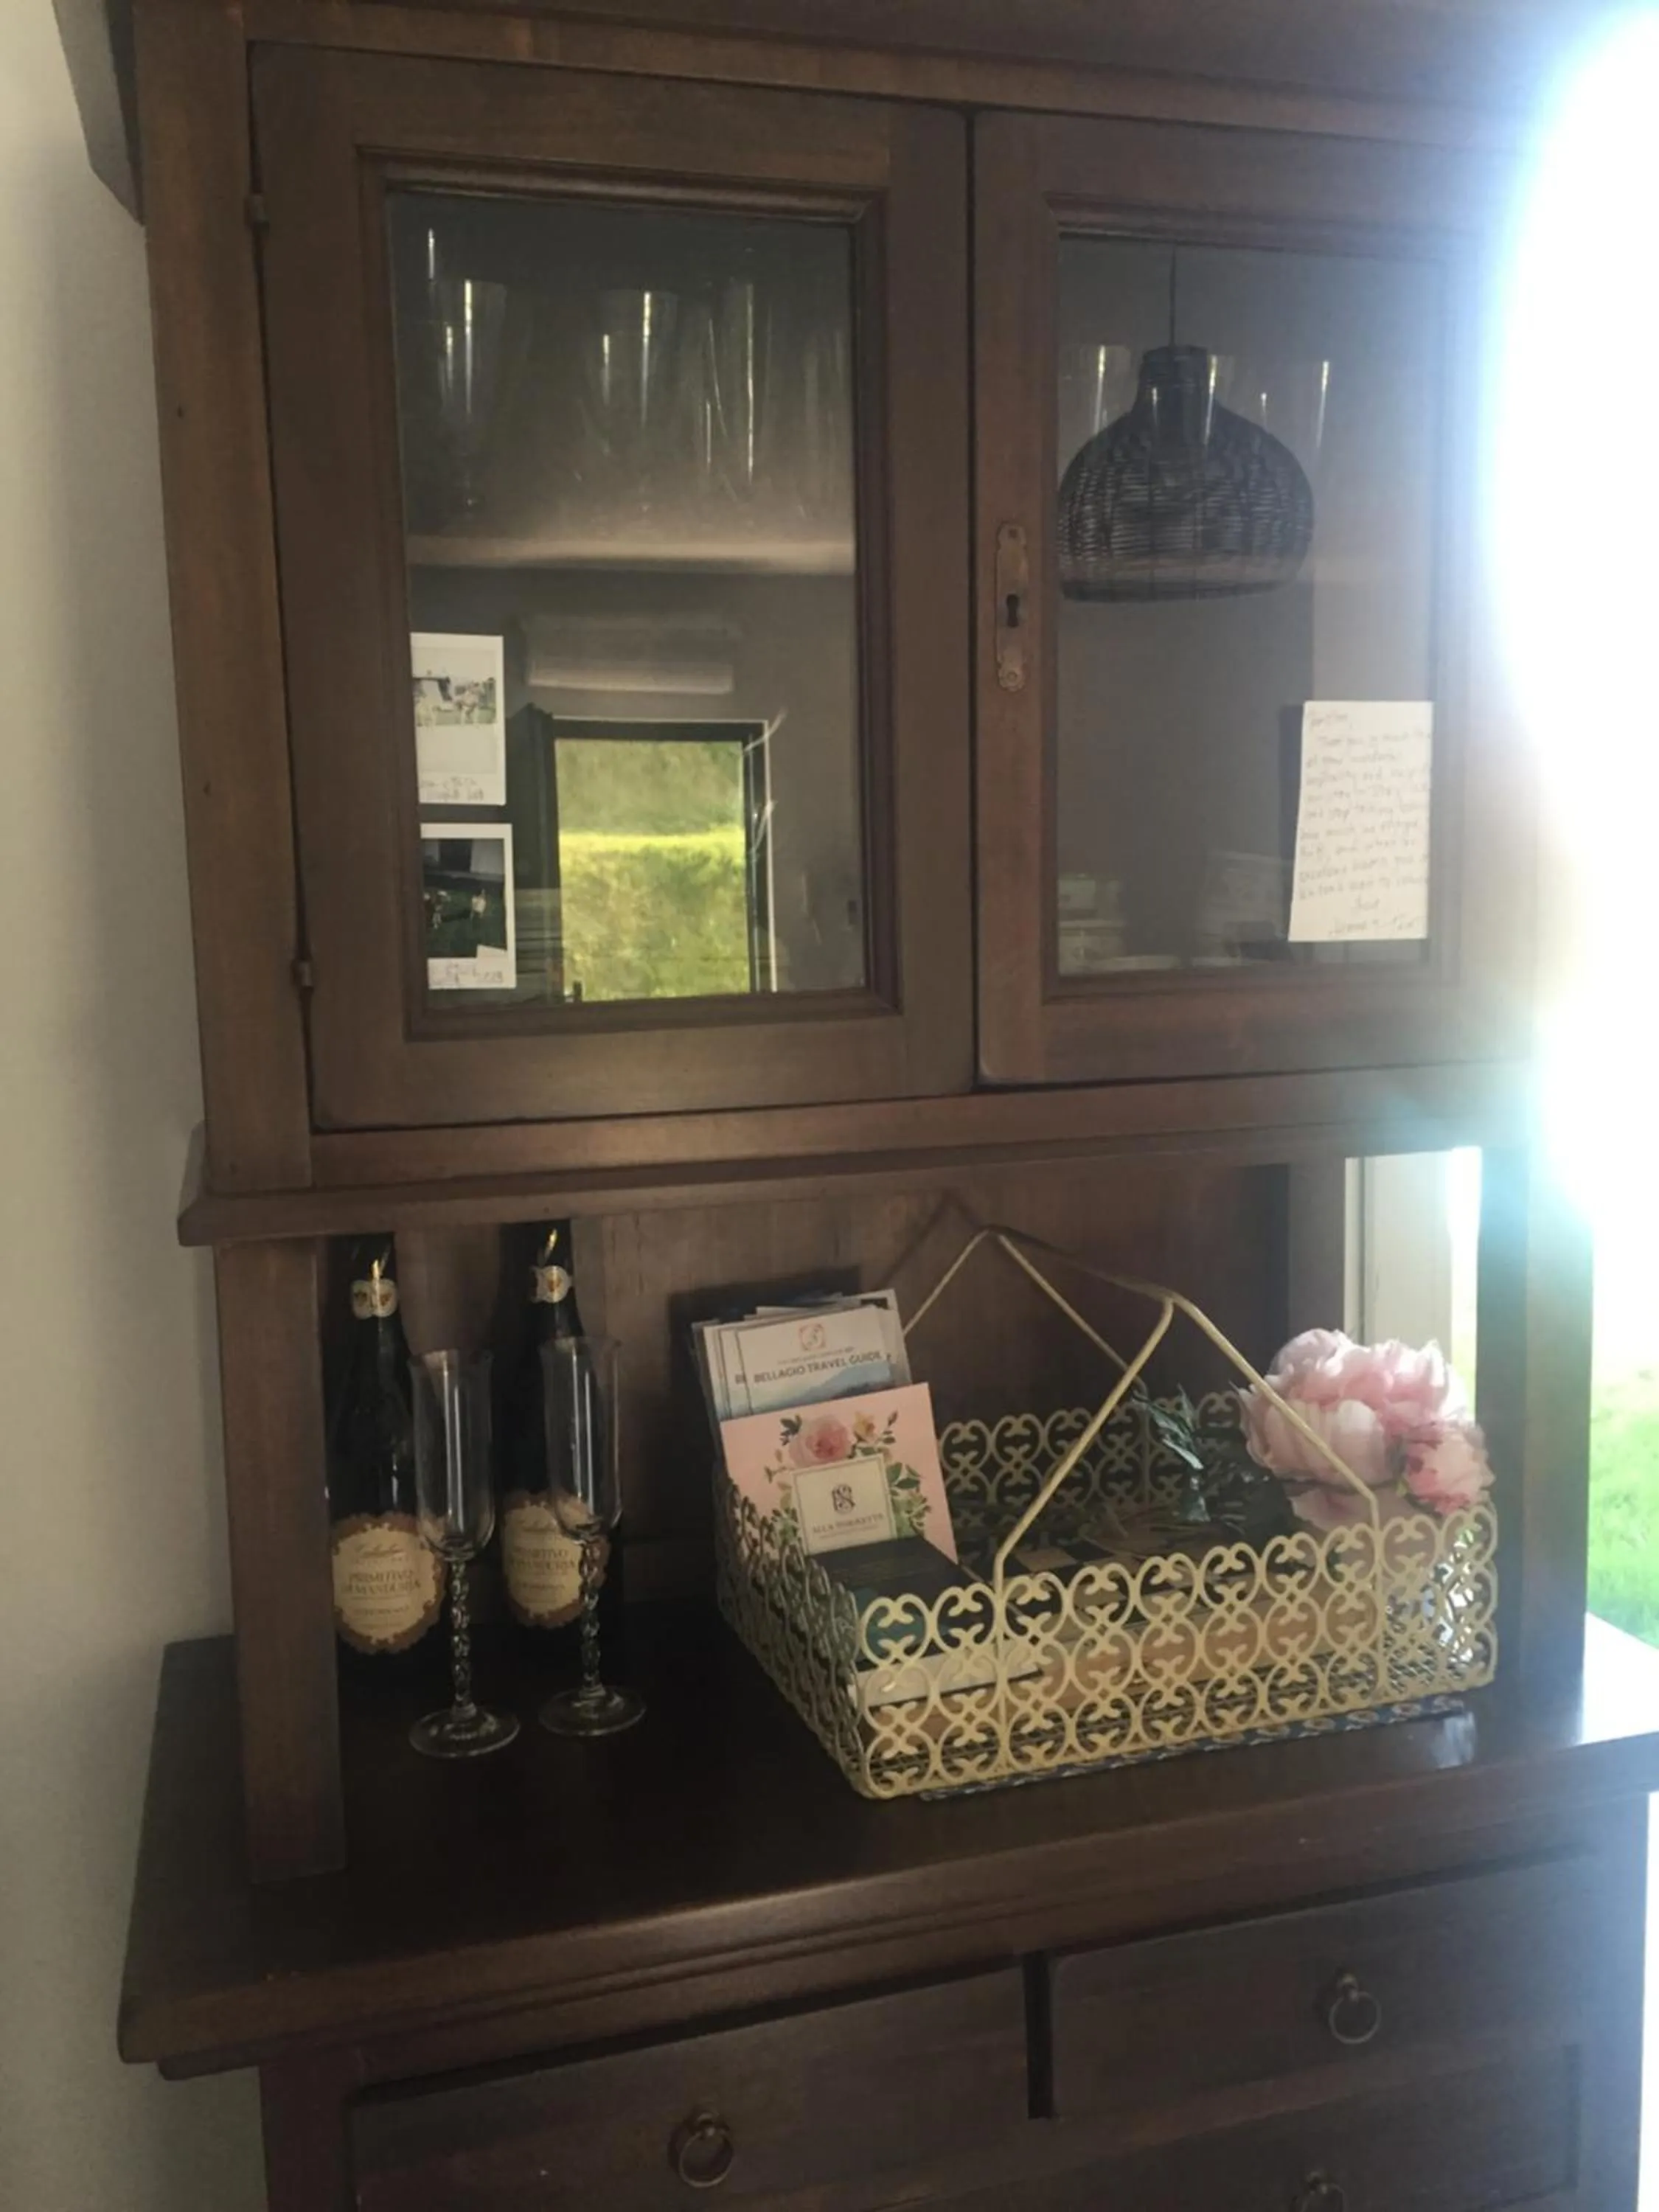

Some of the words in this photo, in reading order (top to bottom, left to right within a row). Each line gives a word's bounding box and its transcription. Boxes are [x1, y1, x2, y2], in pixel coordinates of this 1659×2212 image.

[754, 1365, 806, 1383] BELLAGIO
[807, 1357, 846, 1373] TRAVEL
[848, 1351, 882, 1365] GUIDE
